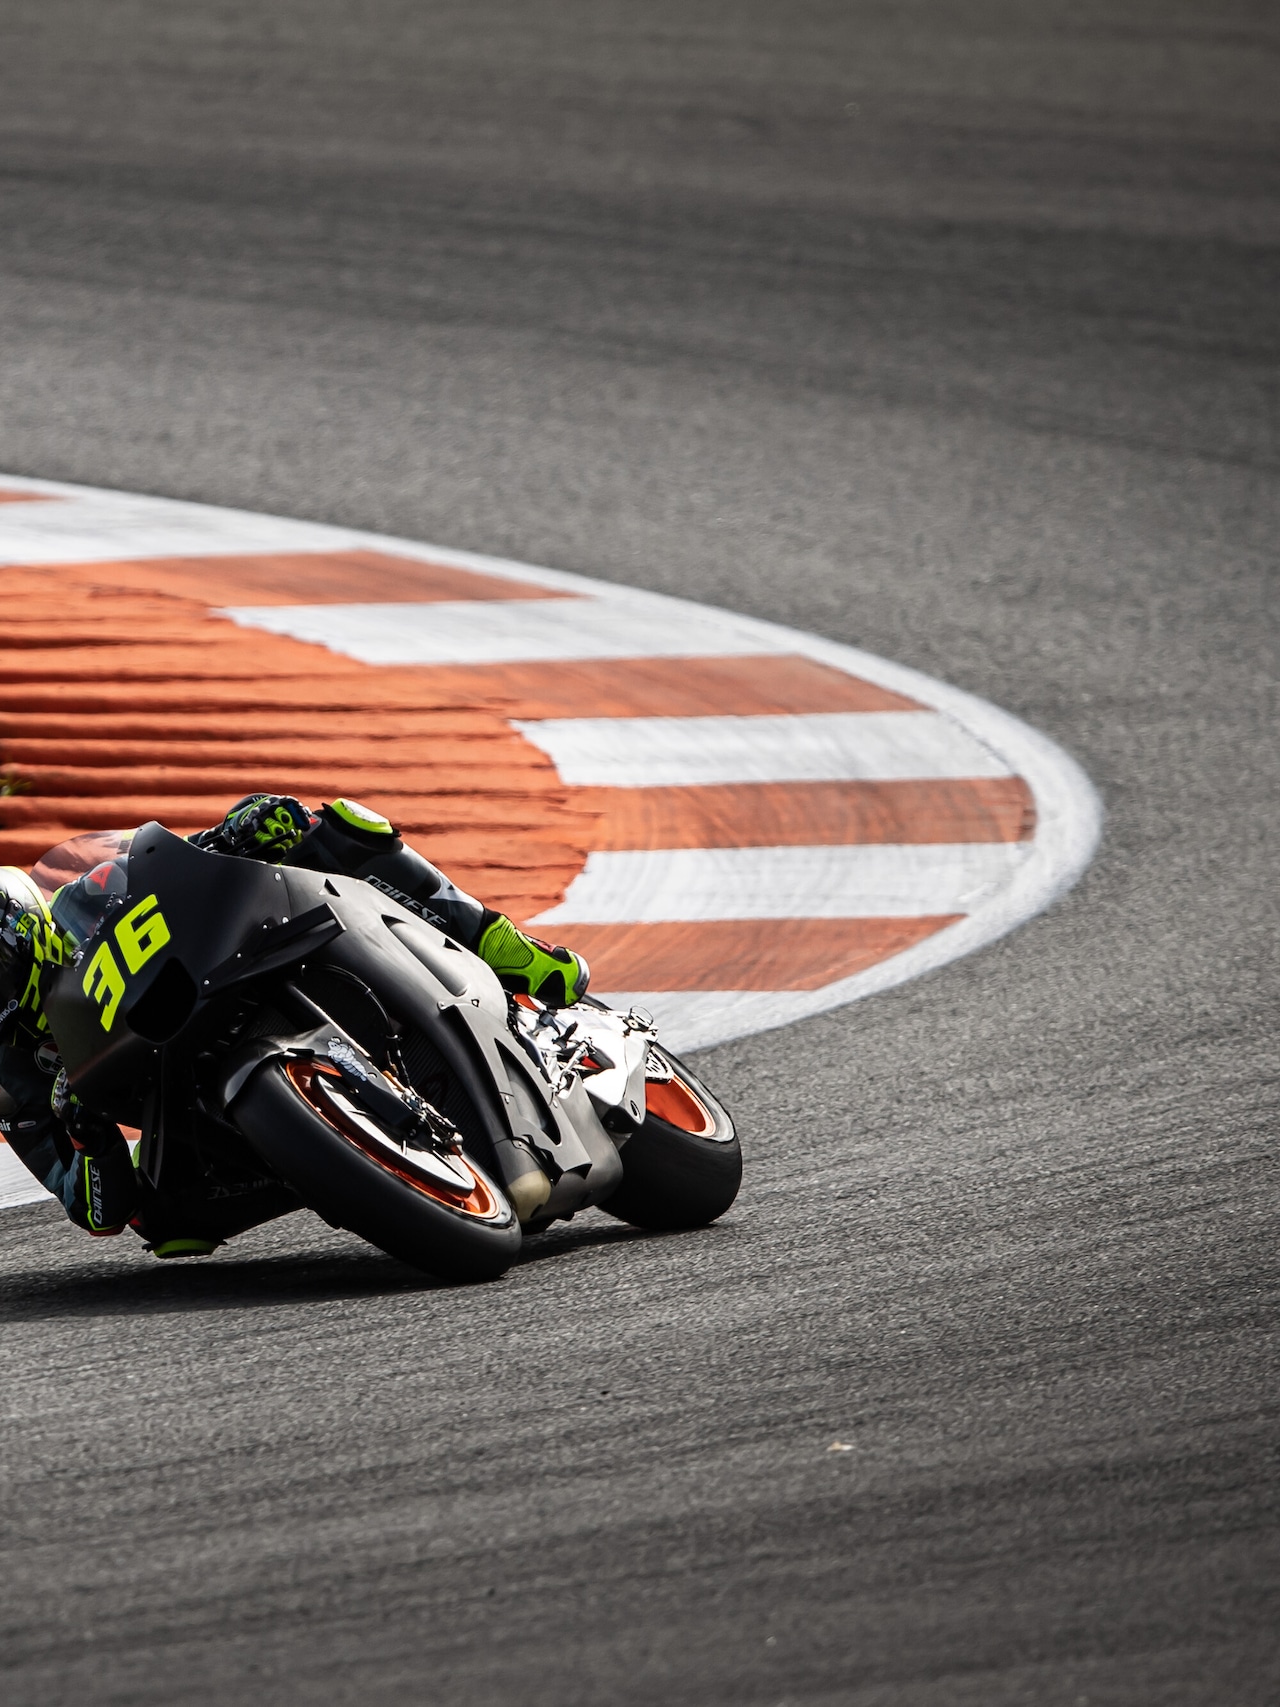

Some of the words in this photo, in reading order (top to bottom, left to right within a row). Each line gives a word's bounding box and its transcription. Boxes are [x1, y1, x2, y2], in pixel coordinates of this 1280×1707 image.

[364, 874, 448, 926] DAINESE
[82, 893, 171, 1032] 36
[89, 1163, 103, 1225] DAINESE
